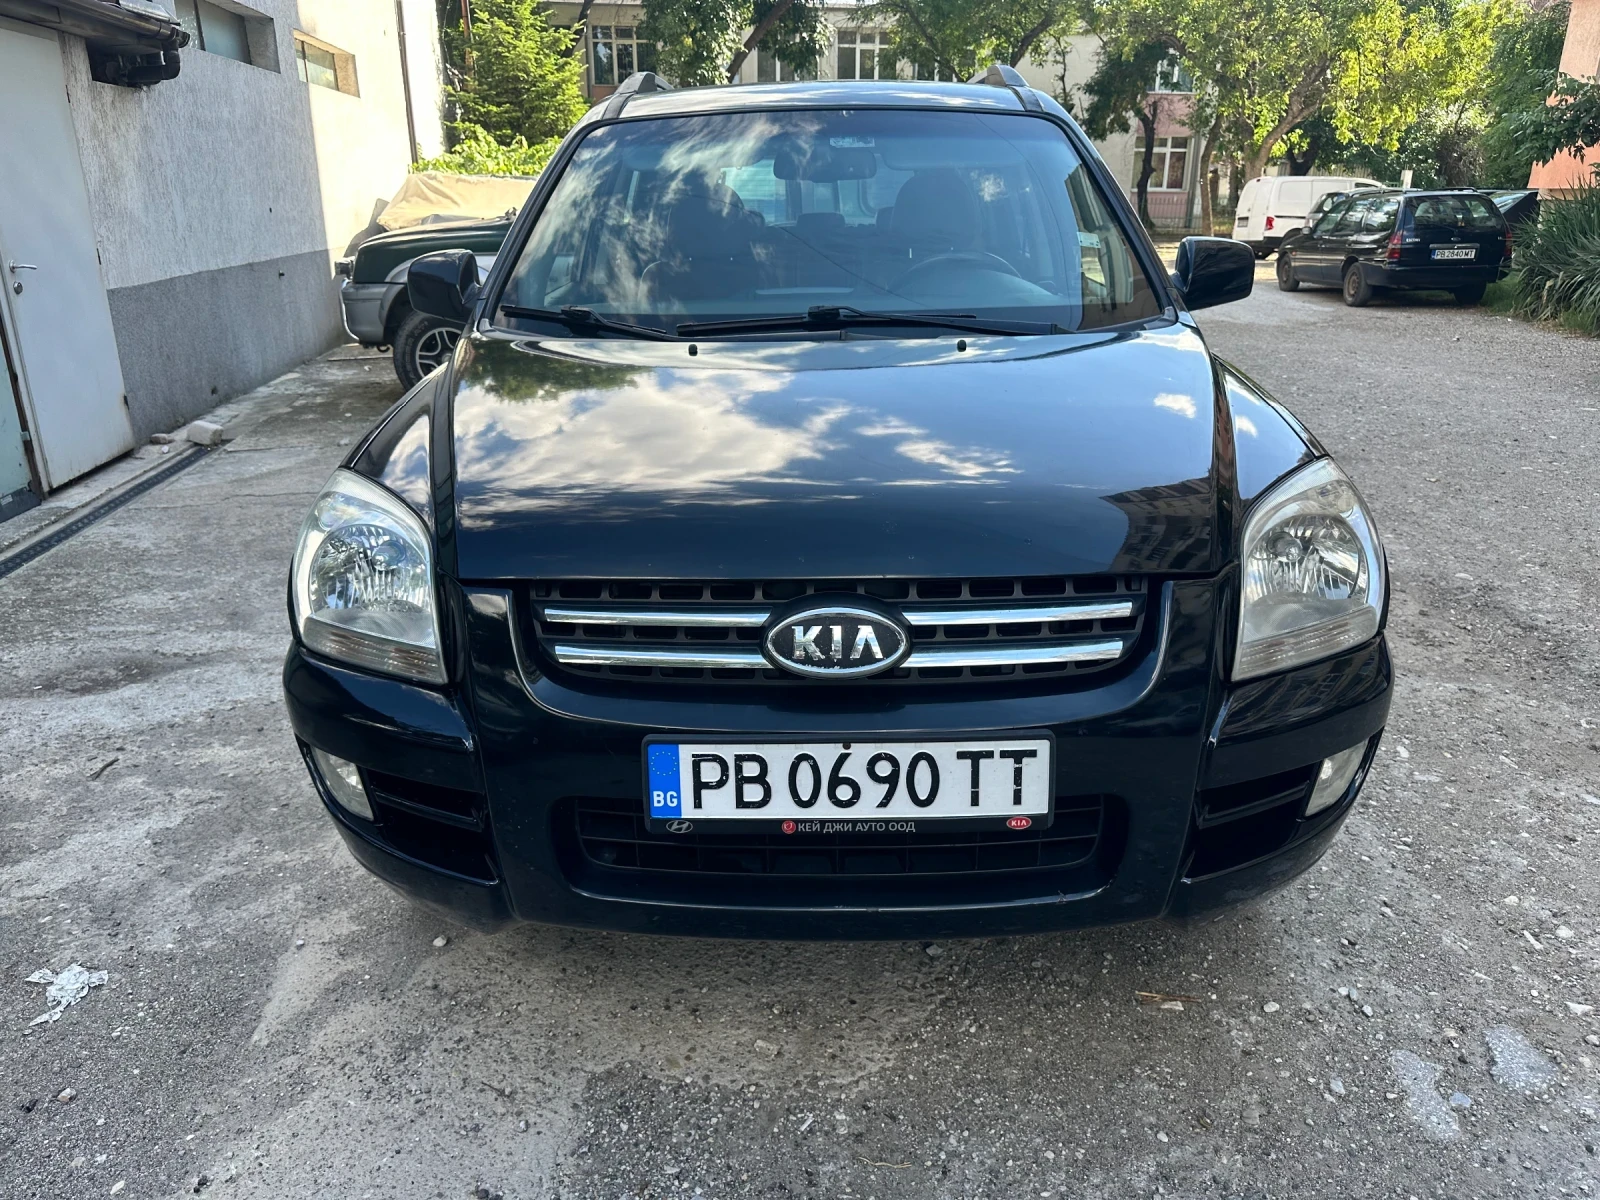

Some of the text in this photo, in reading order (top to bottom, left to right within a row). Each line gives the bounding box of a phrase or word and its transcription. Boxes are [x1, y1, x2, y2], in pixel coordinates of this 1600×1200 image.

[791, 625, 884, 660] KIA
[692, 749, 1038, 809] PB 0690 TT
[653, 791, 678, 807] BG
[798, 821, 916, 833] КЕЙ ДЖИ АУТО ООД
[1011, 819, 1027, 827] KIA
